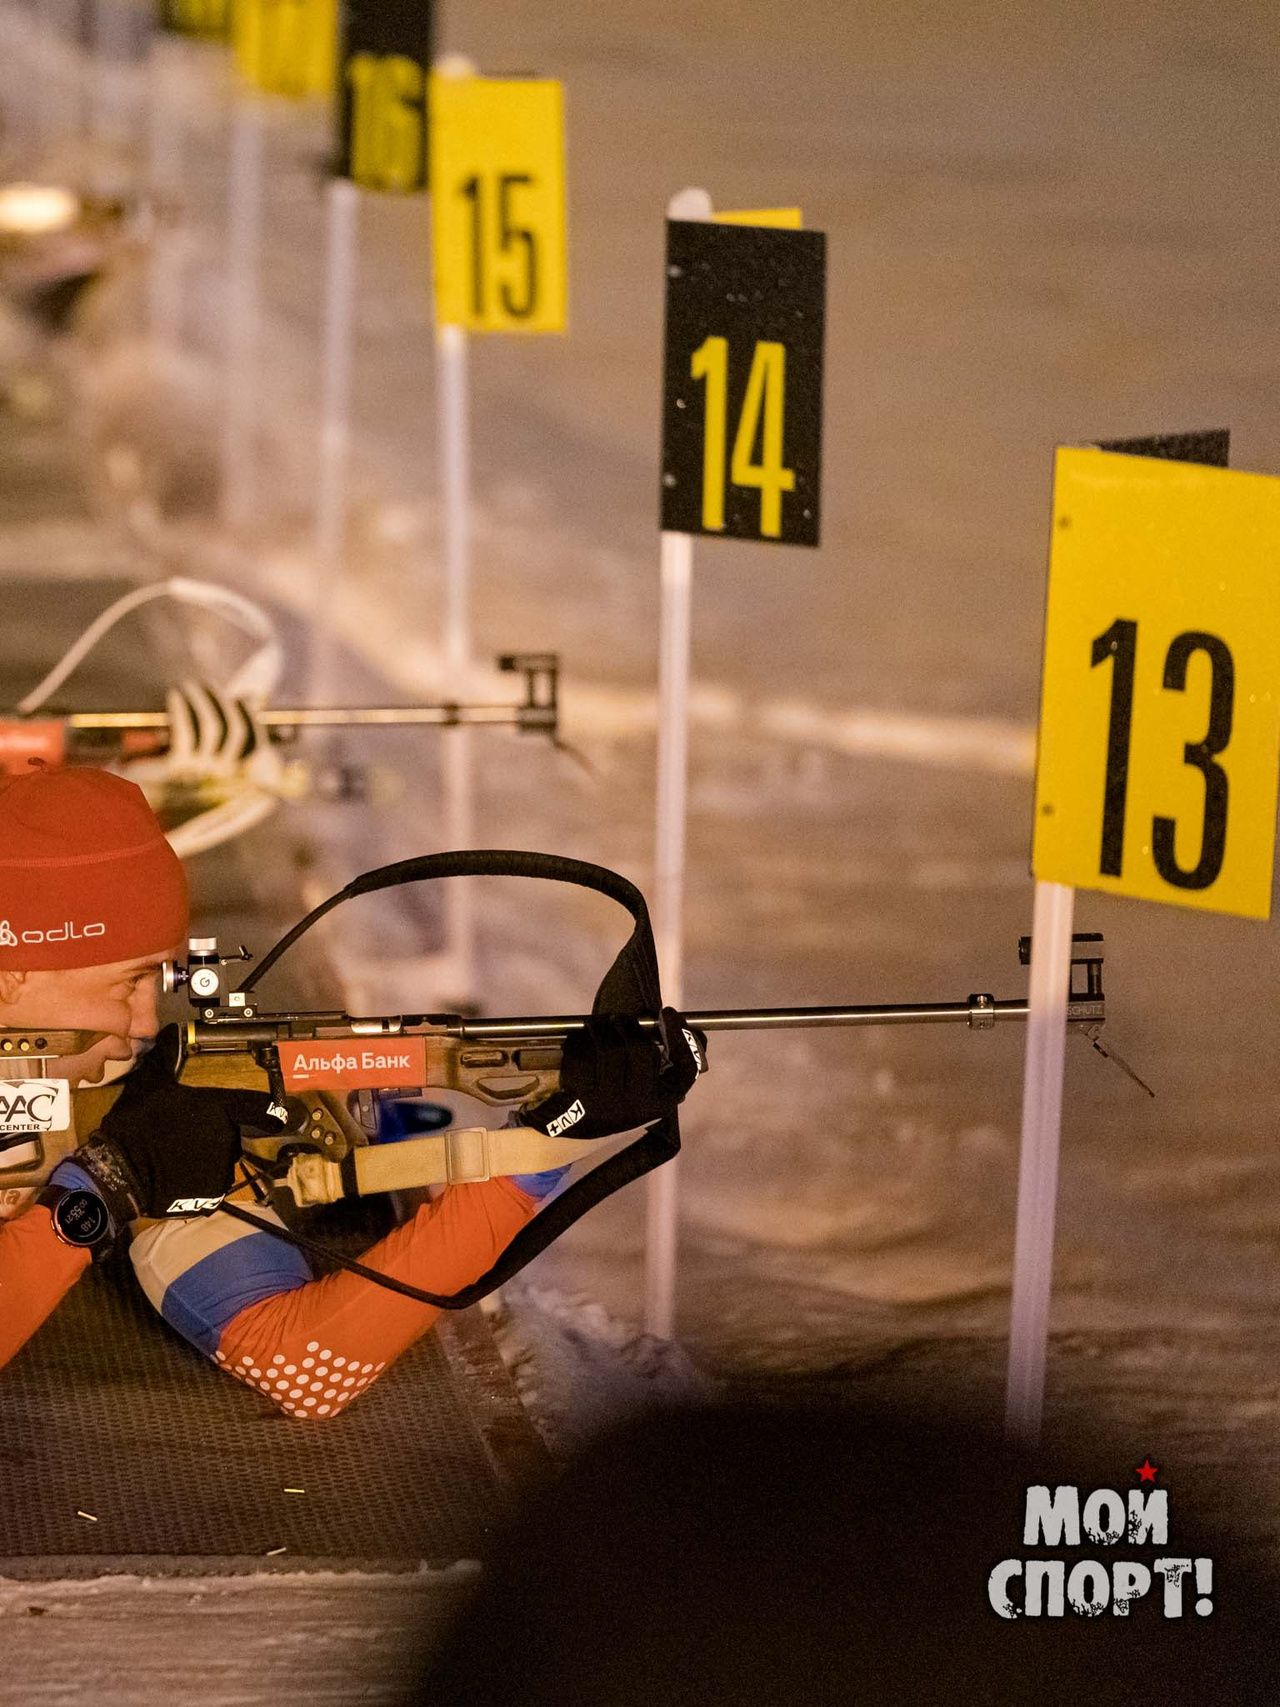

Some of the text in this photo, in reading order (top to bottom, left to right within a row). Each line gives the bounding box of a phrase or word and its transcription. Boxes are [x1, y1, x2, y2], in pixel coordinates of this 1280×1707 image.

[459, 174, 540, 319] 15
[690, 335, 796, 538] 14
[1090, 617, 1235, 891] 13
[22, 920, 105, 943] odlo
[293, 1052, 411, 1074] Альфа Банк
